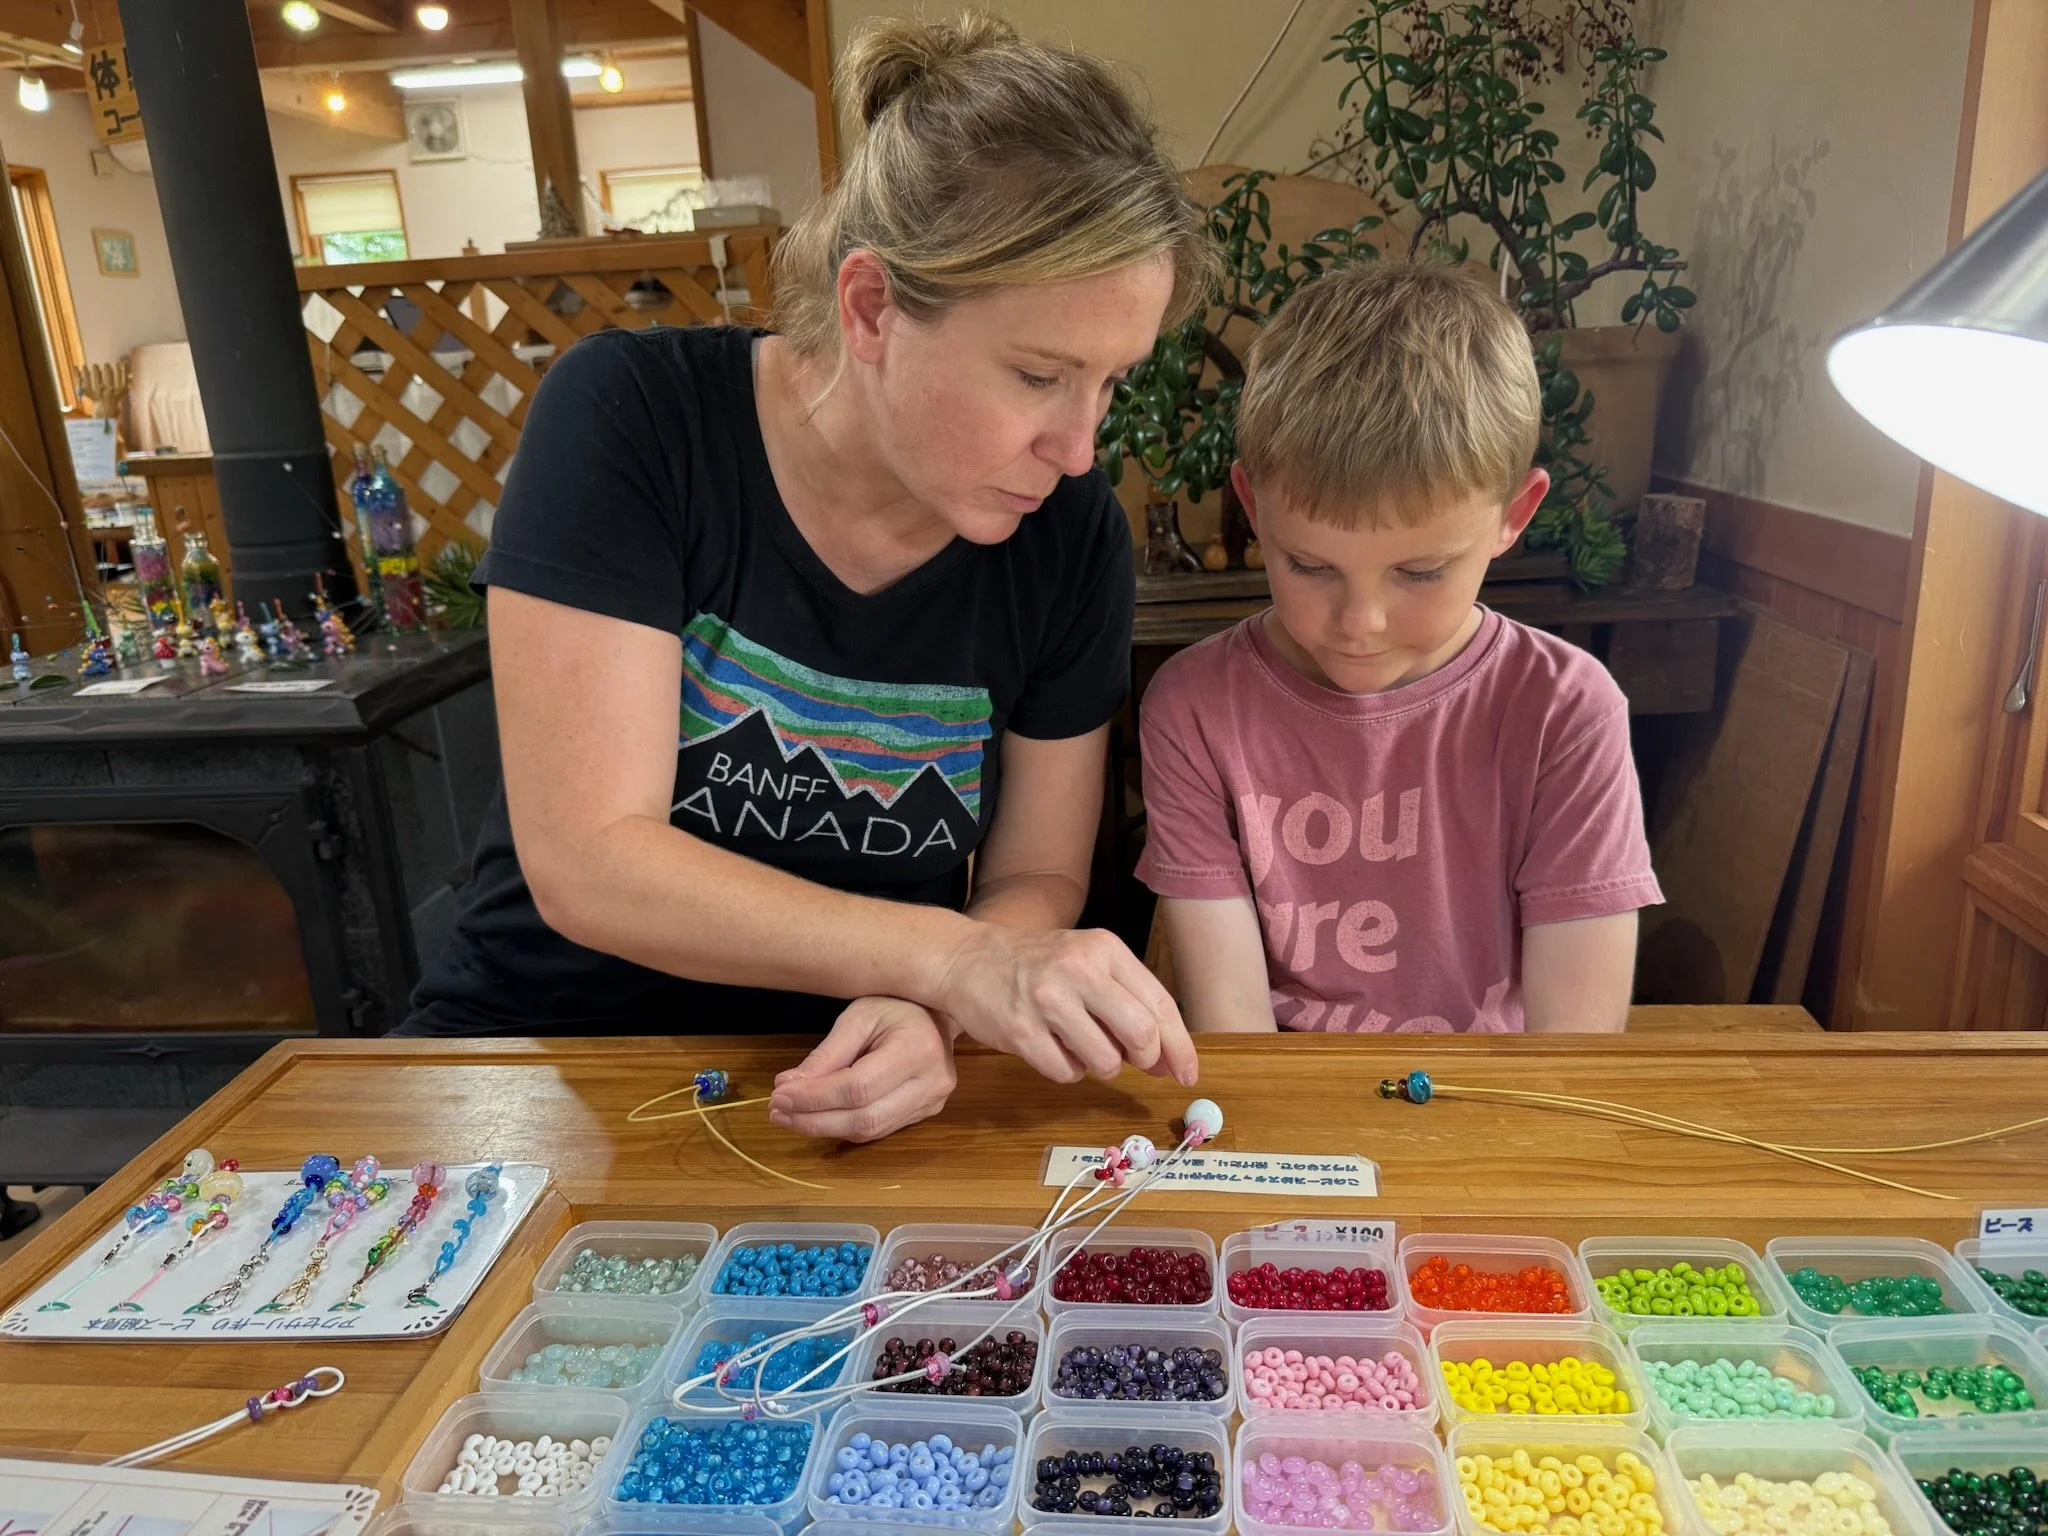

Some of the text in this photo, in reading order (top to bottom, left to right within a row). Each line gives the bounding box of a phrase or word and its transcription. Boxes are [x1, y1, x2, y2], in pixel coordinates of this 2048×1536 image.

[90, 48, 134, 101] 体
[103, 108, 141, 136] コー
[706, 752, 829, 802] BANFF
[670, 786, 957, 858] ANADA
[1984, 1217, 2034, 1234] ビーズ
[212, 1315, 361, 1331] アクセサリー作り
